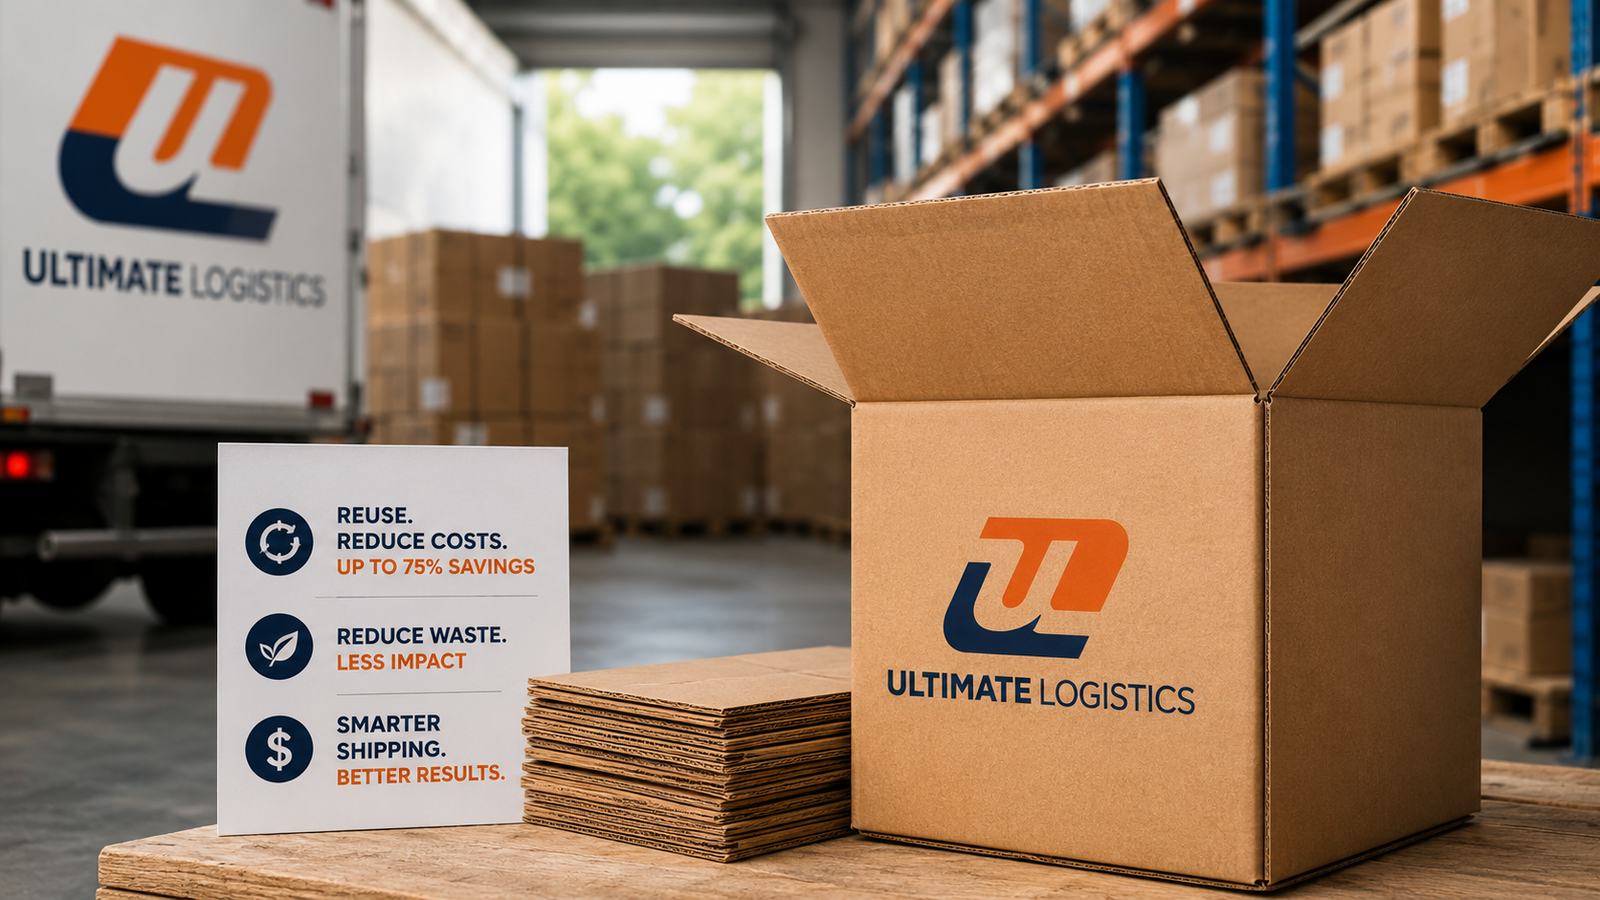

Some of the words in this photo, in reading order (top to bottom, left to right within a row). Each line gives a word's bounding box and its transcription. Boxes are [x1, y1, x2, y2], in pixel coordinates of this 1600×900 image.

[23, 248, 183, 297] ULTIMATE
[190, 264, 326, 308] LOGISTICS
[337, 507, 413, 524] REUSE.
[337, 532, 425, 550] REDUCE
[431, 532, 507, 549] COSTS.
[337, 559, 364, 575] UP
[369, 559, 397, 575] TO
[403, 558, 443, 576] 75%
[448, 558, 536, 575] SAVINGS
[337, 627, 424, 645] REDUCE
[430, 625, 507, 644] WASTE.
[337, 653, 385, 671] LESS
[391, 652, 467, 670] IMPACT
[887, 669, 1032, 704] ULTIMATE
[1040, 678, 1196, 715] LOGISTICS
[337, 714, 440, 734] SMARTER
[337, 740, 446, 760] SHIPPING.
[337, 767, 410, 786] BETTER
[417, 764, 506, 784] RESULTS.
